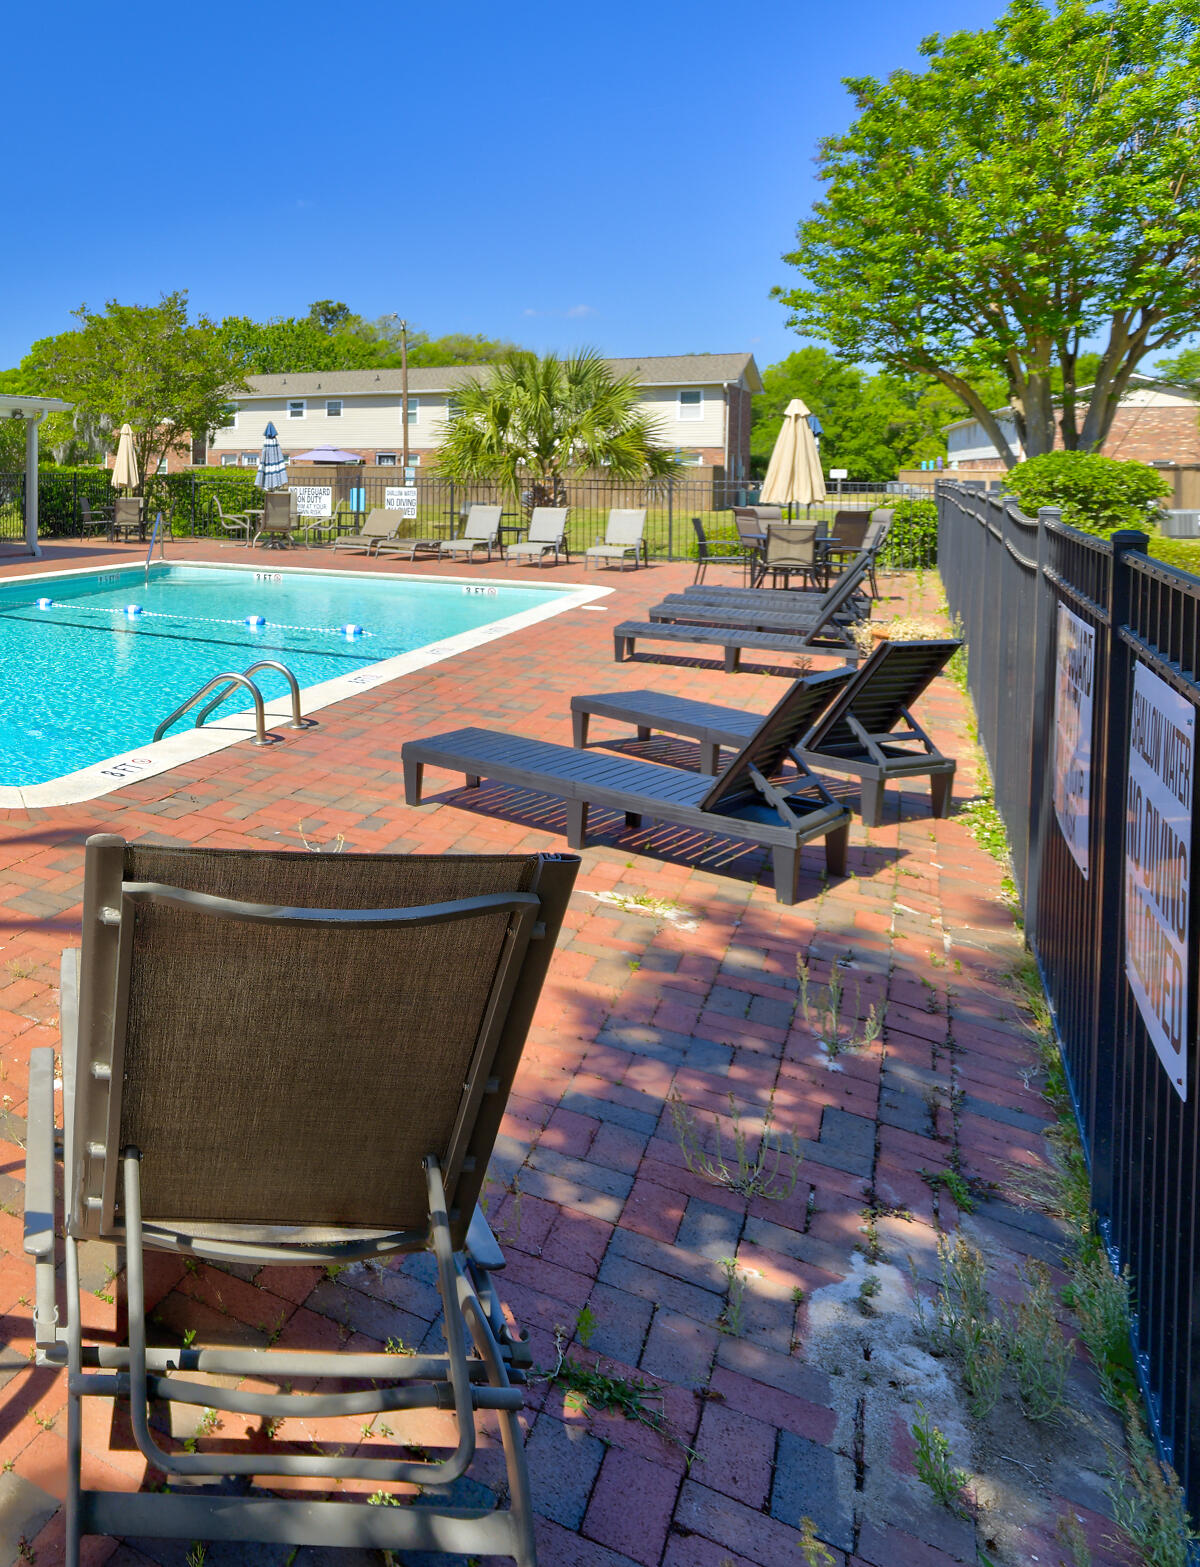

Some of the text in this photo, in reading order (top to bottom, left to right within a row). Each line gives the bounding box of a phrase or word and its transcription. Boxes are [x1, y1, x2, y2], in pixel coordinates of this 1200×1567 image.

[300, 488, 330, 496] LIFEGUARD
[112, 763, 144, 773] FT
[1132, 690, 1191, 811] SHALLOW WATER
[1127, 776, 1188, 944] NO DIVING
[1127, 872, 1183, 1056] ALLOWED
